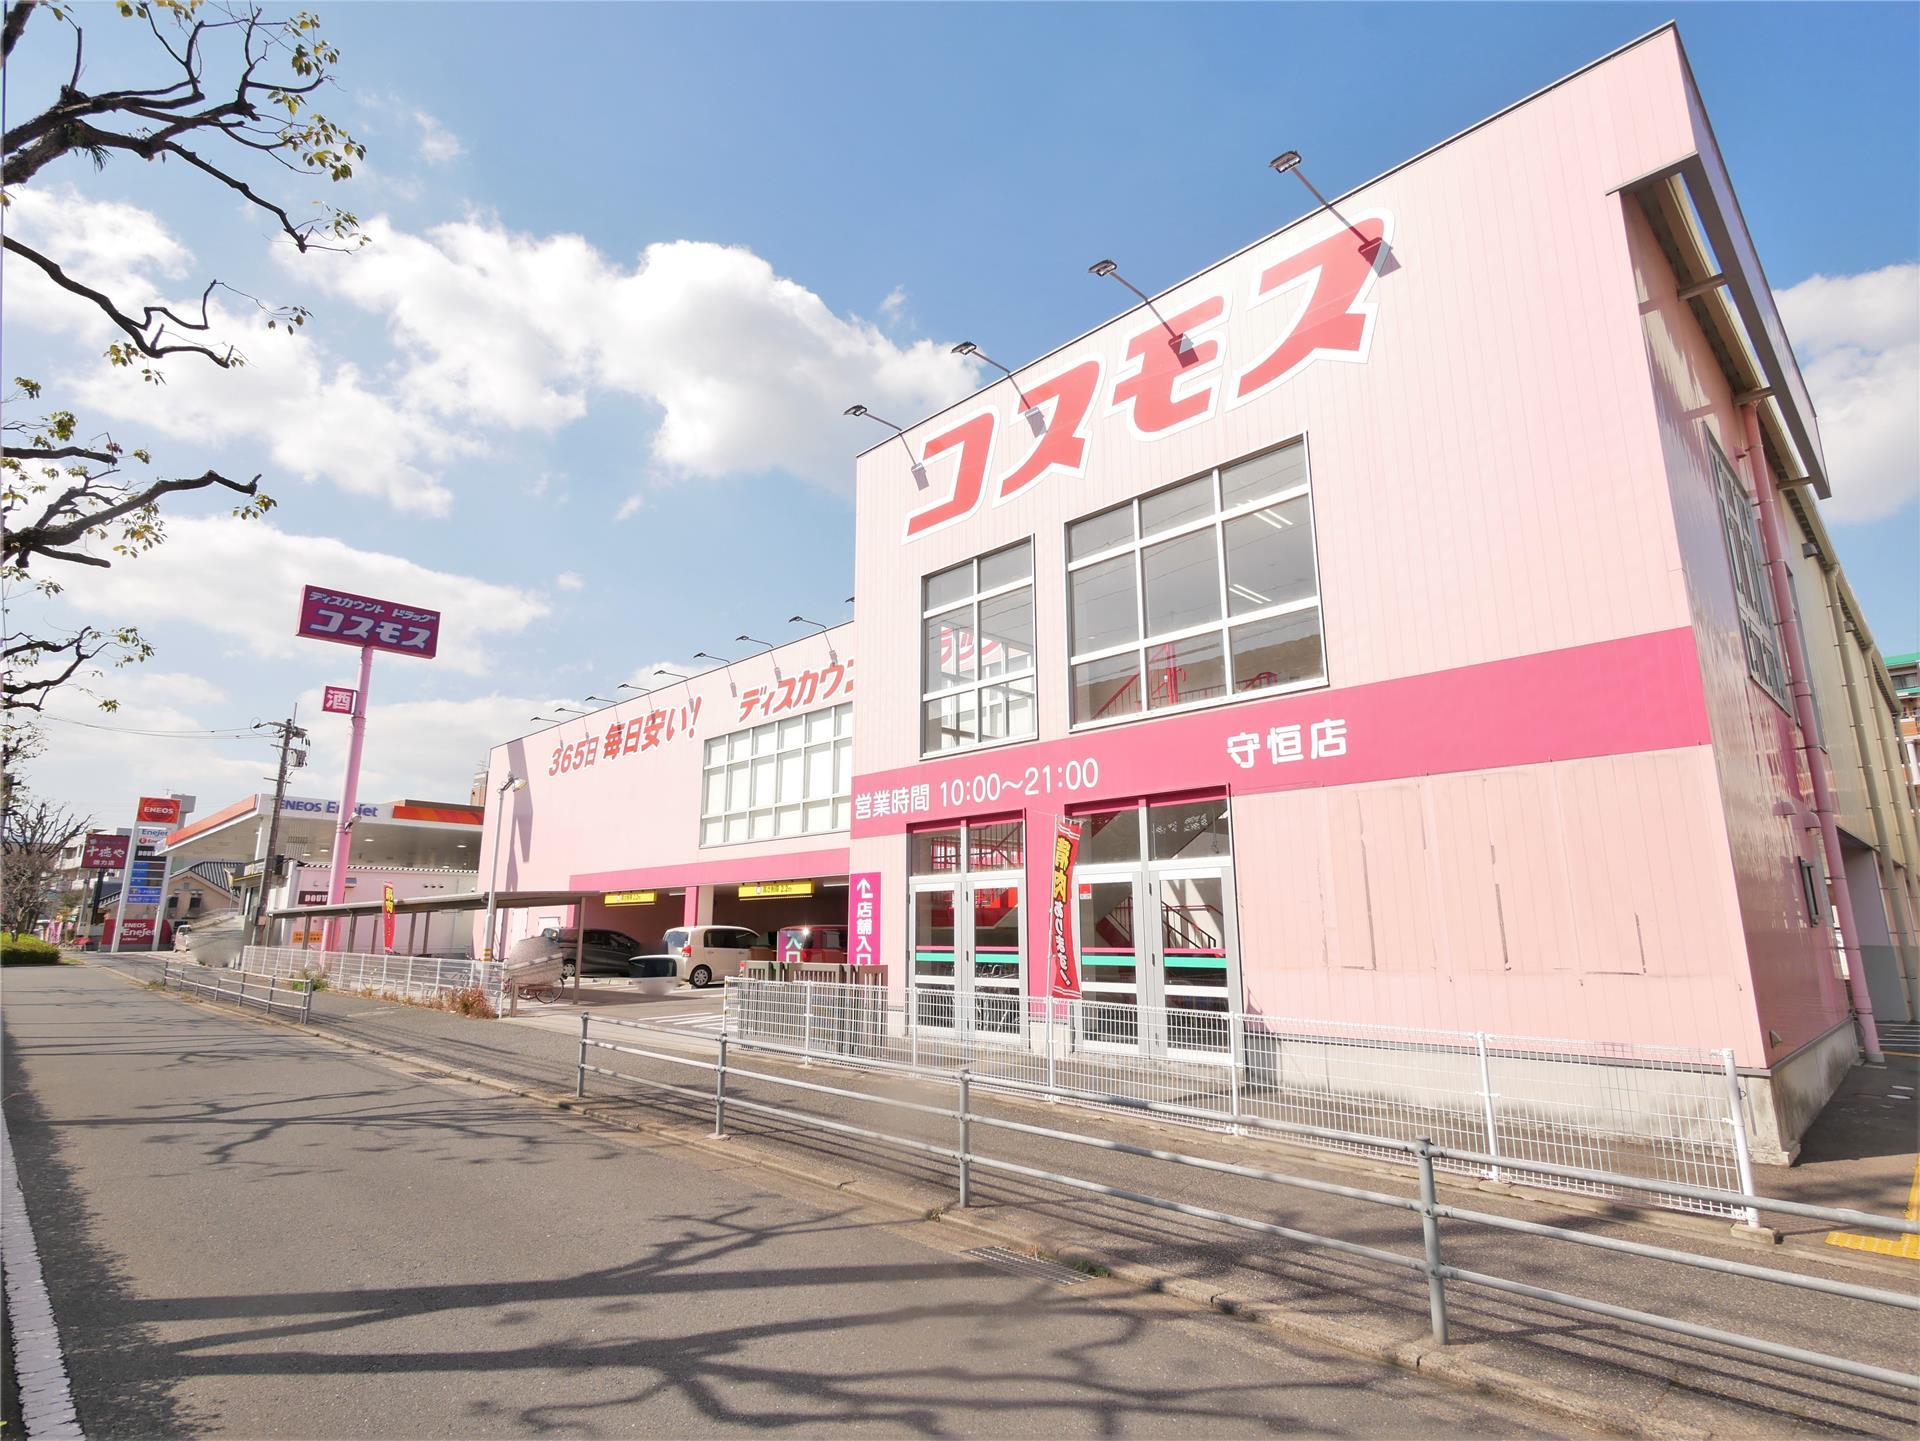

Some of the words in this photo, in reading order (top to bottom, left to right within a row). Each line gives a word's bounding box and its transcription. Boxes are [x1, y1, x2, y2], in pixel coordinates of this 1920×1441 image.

[902, 211, 1393, 541] コスモス
[309, 591, 385, 613] ディスカウント
[392, 608, 431, 622] ドラッグ
[309, 608, 431, 649] コスモス
[325, 689, 353, 711] 酒
[548, 736, 600, 776] 365日
[602, 696, 702, 760] 毎日安い!
[1227, 718, 1347, 768] 守恒店
[144, 806, 174, 814] ENEOS
[855, 784, 930, 820] 営業時間
[856, 901, 873, 965] 店舗入口
